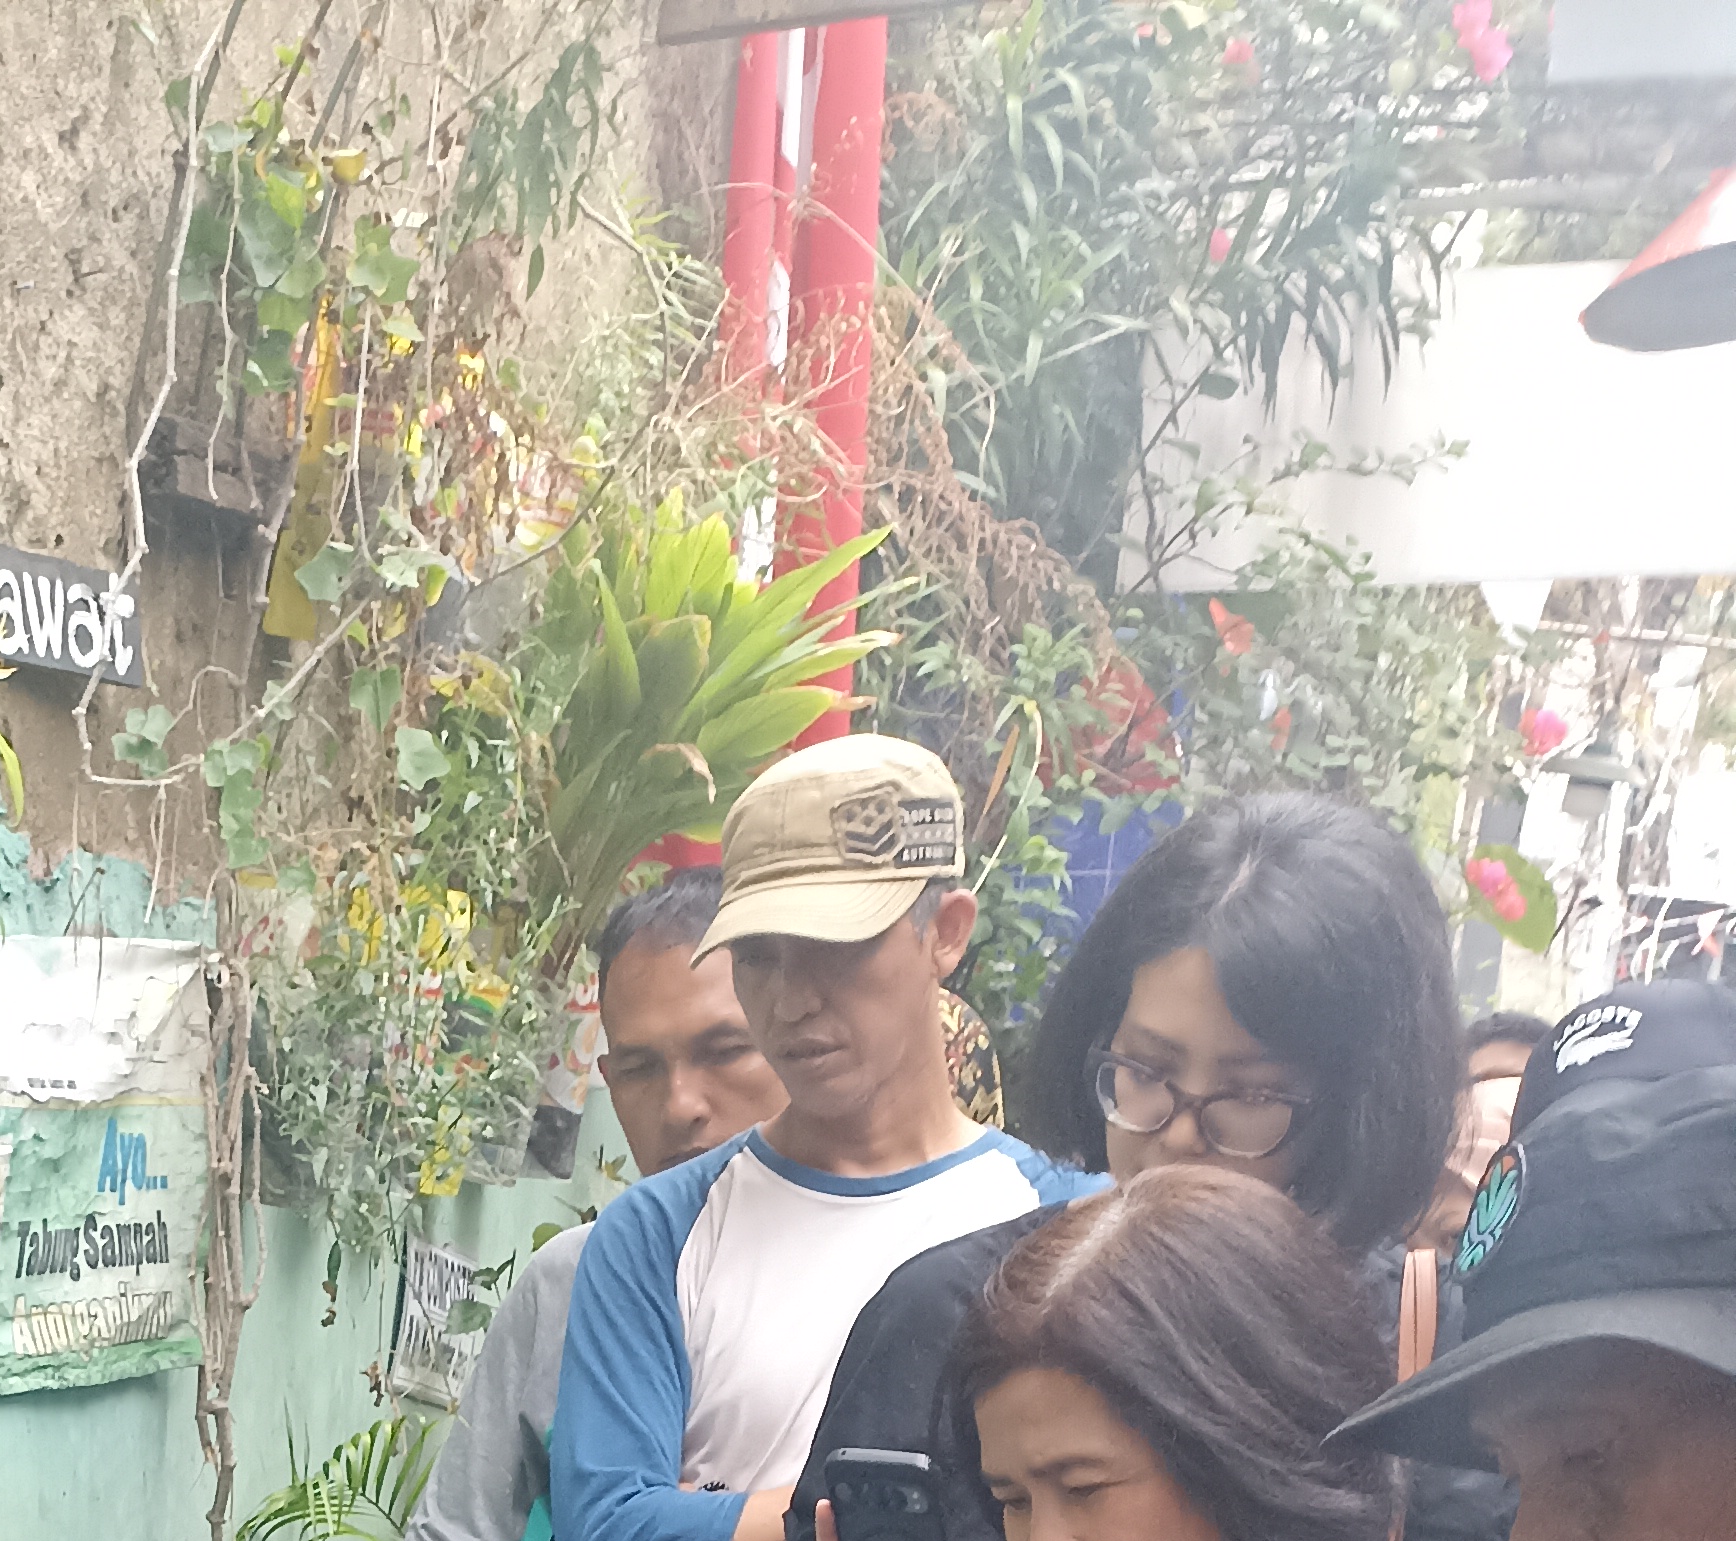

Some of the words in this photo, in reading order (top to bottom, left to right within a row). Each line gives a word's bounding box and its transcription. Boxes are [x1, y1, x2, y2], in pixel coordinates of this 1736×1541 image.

[97, 1116, 169, 1206] Ayo...
[14, 1219, 81, 1282] Tabung
[83, 1210, 170, 1280] Sampah
